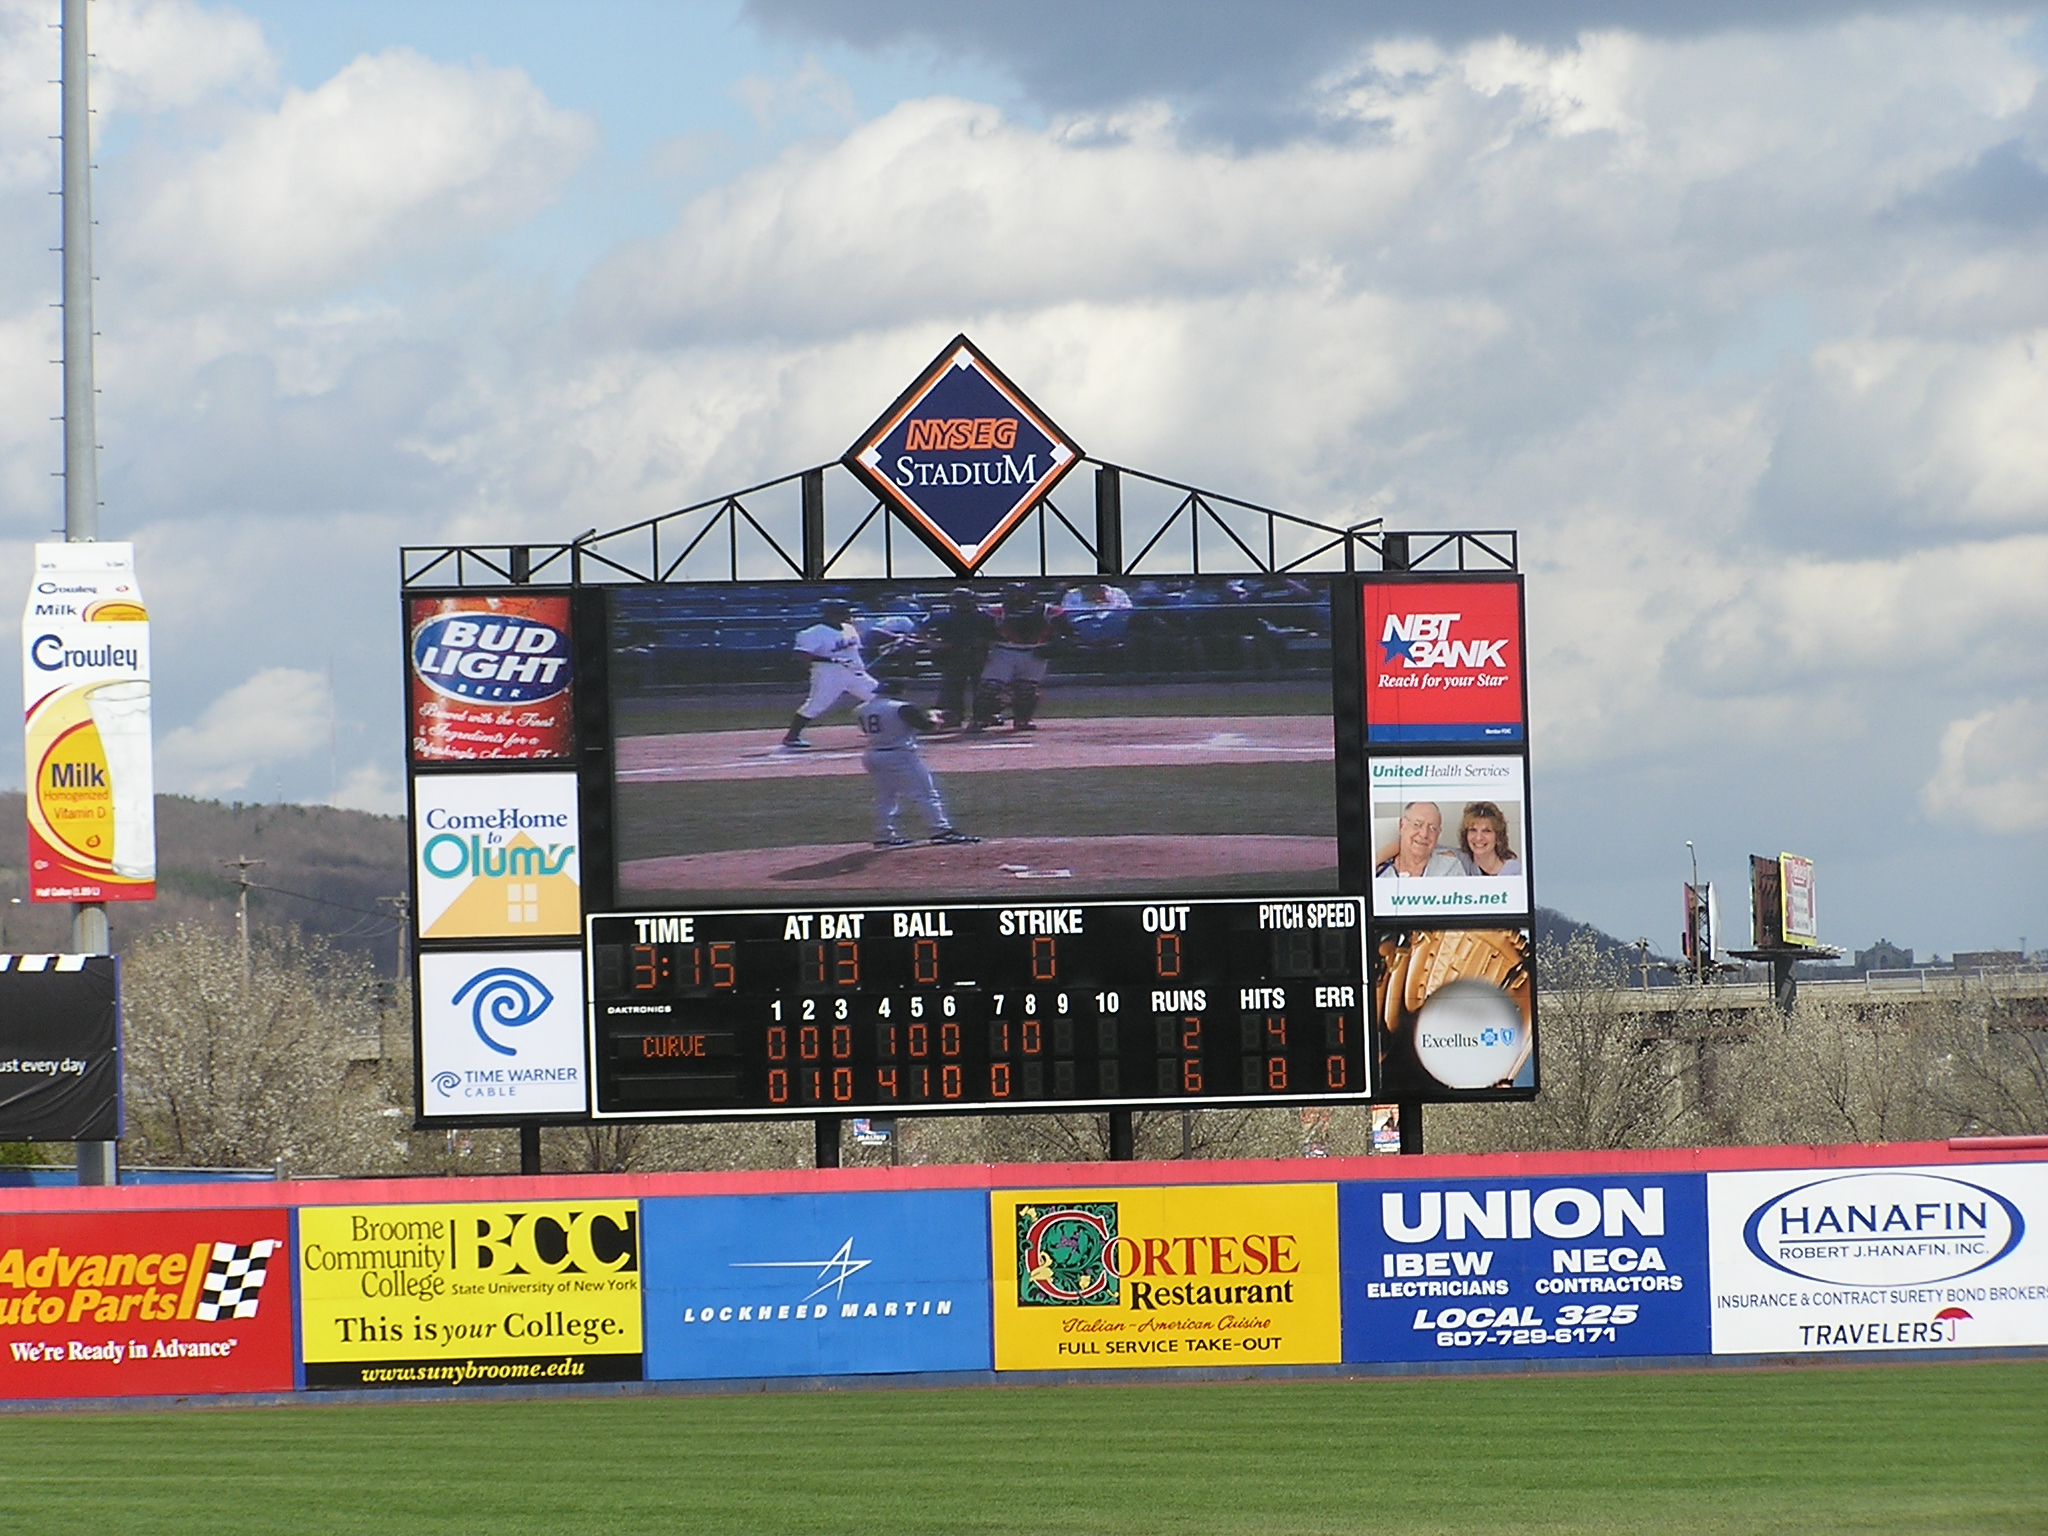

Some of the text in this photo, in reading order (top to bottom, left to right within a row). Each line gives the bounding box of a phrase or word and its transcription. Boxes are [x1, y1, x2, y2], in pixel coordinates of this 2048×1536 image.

[905, 418, 1019, 450] NYSEG
[896, 454, 1037, 487] STADIUM
[38, 582, 97, 594] Crowley
[35, 604, 77, 615] Milk
[441, 621, 557, 654] BUD
[1382, 613, 1461, 641] NBT
[32, 634, 138, 671] Crowley
[420, 647, 568, 683] LIGHT
[1403, 640, 1509, 668] BANK
[457, 684, 522, 698] BEER
[1378, 673, 1418, 687] Reach
[1421, 673, 1442, 689] for
[1443, 675, 1474, 690] your
[495, 708, 514, 726] the
[503, 733, 527, 748] for
[52, 763, 105, 787] Milk
[1465, 764, 1510, 777] Services
[44, 790, 109, 802] Homogenized
[53, 806, 106, 819] Vitamin D
[487, 831, 502, 845] to
[423, 833, 576, 879] Olum's
[1391, 891, 1508, 905] www.uhs.net
[634, 903, 1355, 944] TIME AT BAT BALL STRIKE OUT PITCH SPEED
[634, 933, 1180, 989] 3:15 13 0 0 0
[607, 1005, 672, 1014] DAKTRONICS
[771, 986, 1354, 1021] 1 2 3 4 5 6 7 8 9 10 RUNS HITS ERR
[1182, 1017, 1200, 1050] 2
[1267, 1017, 1286, 1045] 4
[1338, 1015, 1344, 1044] 1
[1422, 1033, 1478, 1048] Excellus
[642, 1035, 706, 1057] CURVE
[0, 1058, 87, 1076] ust every day
[464, 1068, 578, 1083] TIME WARNER
[1184, 1059, 1202, 1092] 6
[1268, 1057, 1287, 1090] 8
[1327, 1055, 1345, 1088] 0
[464, 1087, 516, 1097] CABLE
[1382, 1187, 1665, 1243] UNION
[1779, 1202, 1987, 1235] HANAFIN
[351, 1215, 445, 1241] Broome
[460, 1210, 638, 1275] BCC
[1779, 1245, 1850, 1259] ROBERT
[1955, 1242, 1989, 1255] INC.
[0, 1247, 188, 1289] Advance
[304, 1244, 446, 1272] Community
[1383, 1251, 1494, 1278] IBEW
[1553, 1247, 1666, 1274] NECA
[361, 1270, 445, 1301] College
[451, 1279, 638, 1296] State University of New York
[1129, 1280, 1294, 1311] Restaurant
[1367, 1279, 1509, 1298] ELECTRICIANS
[1535, 1275, 1683, 1295] CONTRACTORS
[1717, 1285, 2048, 1308] INSURANCE & CONTRACT SURETY BOND BROKER
[0, 1286, 178, 1325] uto Parts
[684, 1301, 952, 1323] LOCKHEED MARTIN
[1412, 1304, 1639, 1330] LOCAL 325
[335, 1311, 625, 1347] This is your College.
[1217, 1315, 1272, 1331] Cuisine
[1799, 1321, 1943, 1346] TRAVELERS
[1058, 1337, 1283, 1355] FULL SERVICE TAKE-OUT
[1436, 1327, 1616, 1347] 607-729-6171
[10, 1341, 65, 1362] We're
[68, 1341, 125, 1365] Ready
[129, 1339, 148, 1359] in
[360, 1358, 586, 1385] www.sunybroome.edu
